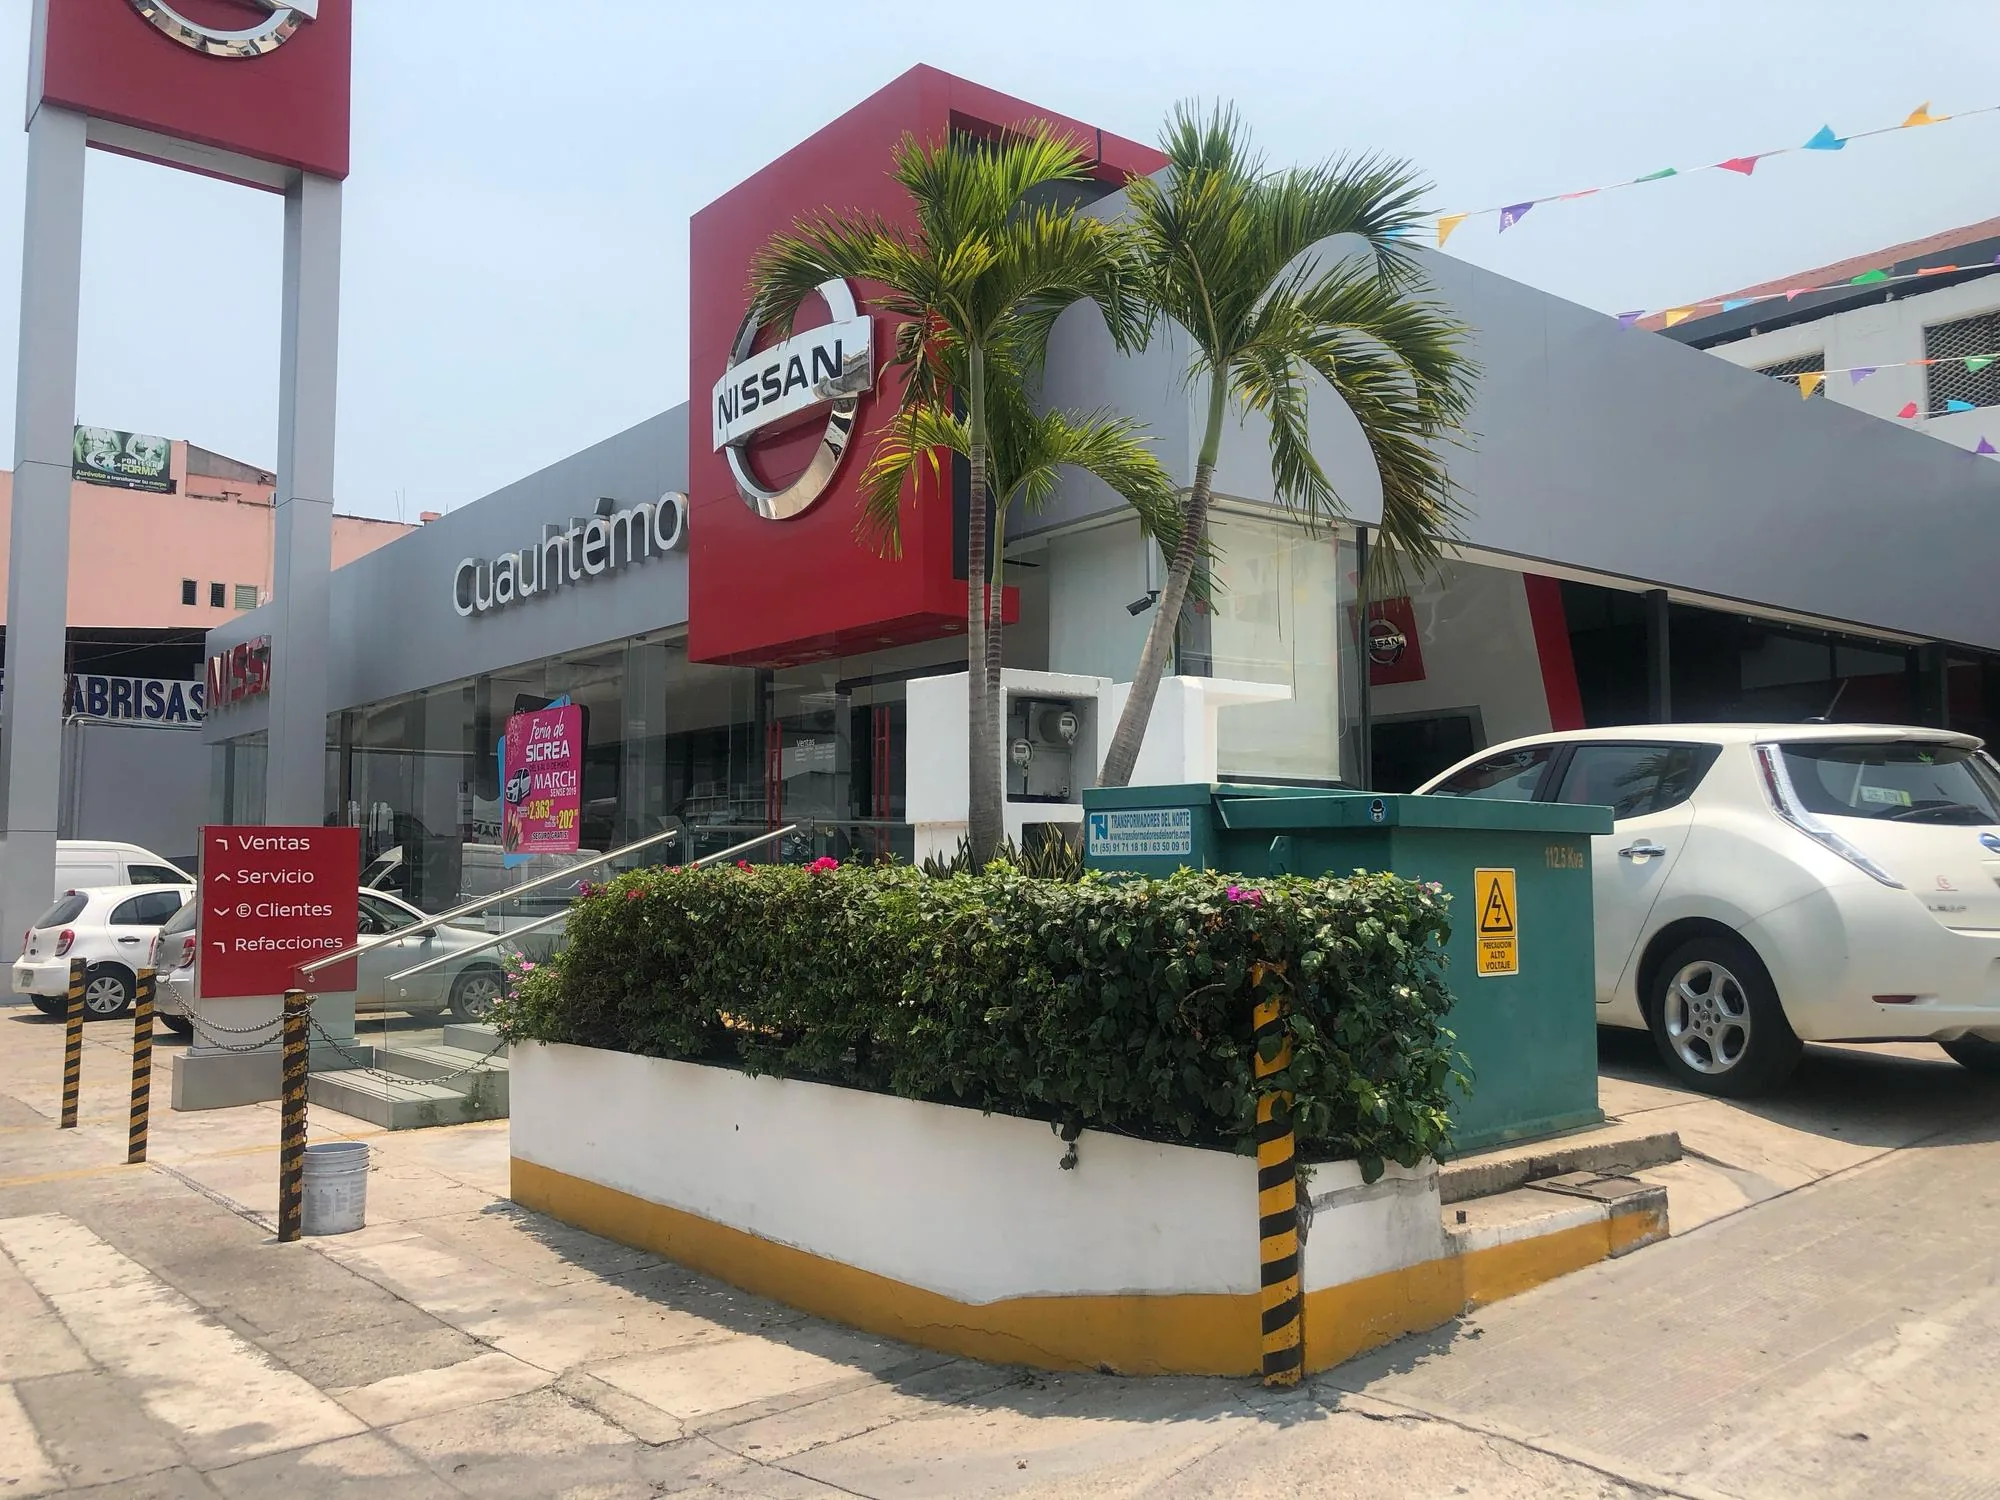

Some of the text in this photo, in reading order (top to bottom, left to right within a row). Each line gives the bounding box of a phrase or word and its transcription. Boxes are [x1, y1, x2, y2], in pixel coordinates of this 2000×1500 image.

[718, 339, 843, 430] NISSAN
[121, 463, 158, 477] FORMA
[453, 490, 689, 617] Cuauhtémo
[529, 710, 565, 744] Feria de
[525, 740, 570, 762] SICREA
[533, 770, 576, 790] MARCH
[550, 788, 566, 797] SENSE
[1111, 811, 1189, 828] TRANSFORMADORES DEL NORTE
[238, 835, 310, 851] Ventas
[1091, 843, 1098, 853] 01
[1112, 842, 1120, 852] 91
[1121, 842, 1129, 852] 71
[236, 869, 315, 884] Servicio
[255, 903, 333, 918] Clientes
[235, 936, 344, 952] Refacciones
[1490, 950, 1506, 959] ALTO
[1485, 960, 1511, 970] VOLTAJE
